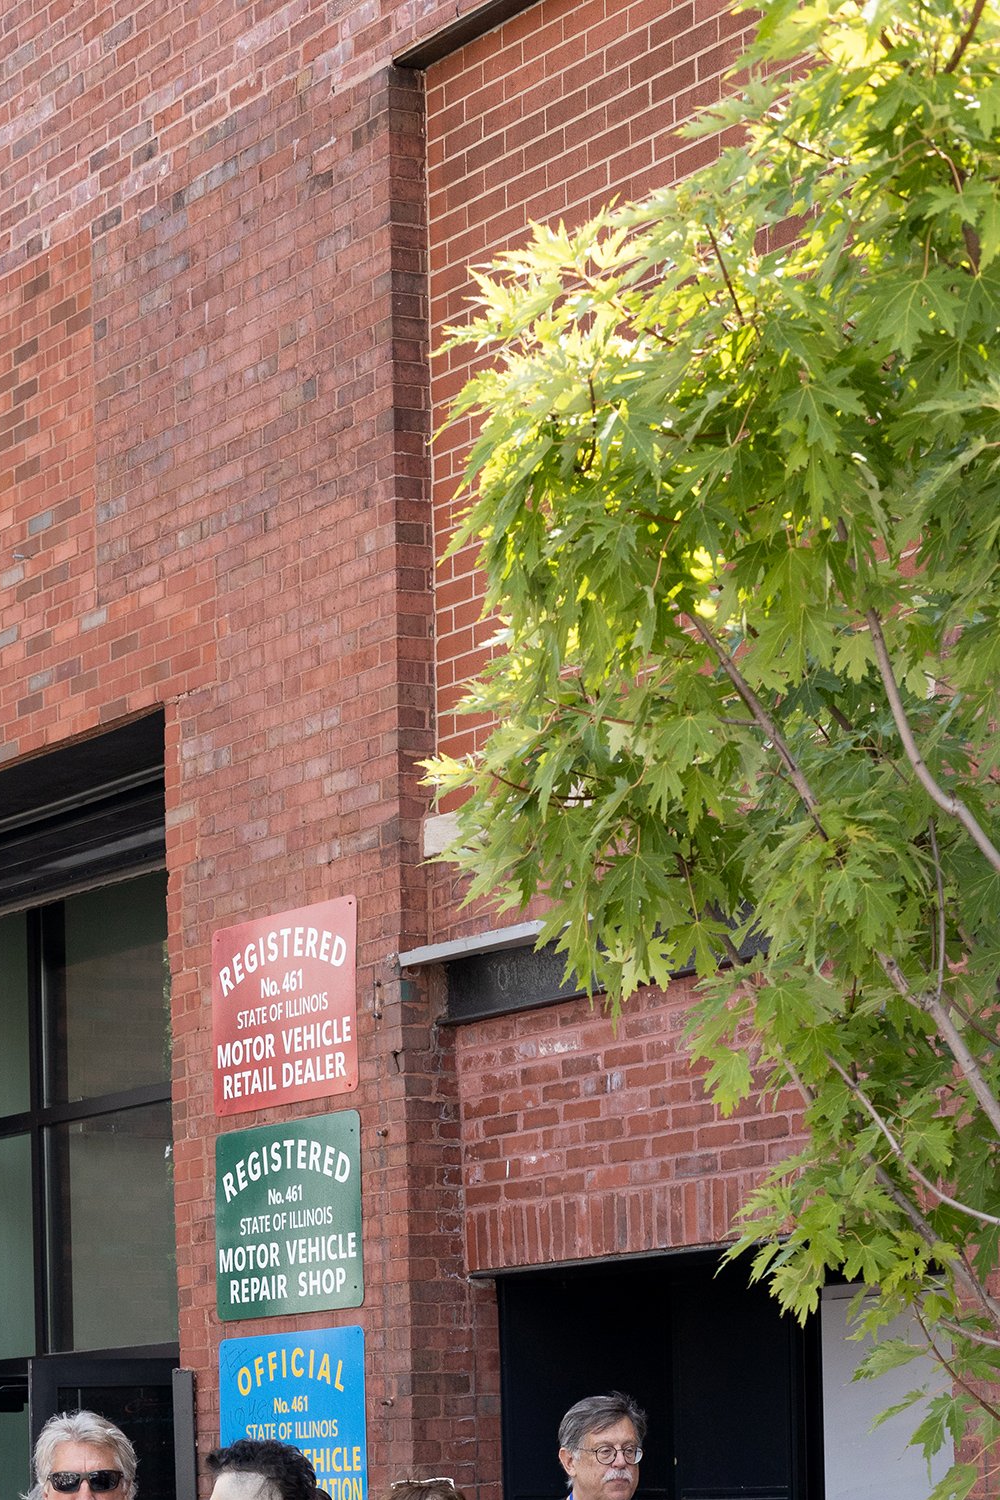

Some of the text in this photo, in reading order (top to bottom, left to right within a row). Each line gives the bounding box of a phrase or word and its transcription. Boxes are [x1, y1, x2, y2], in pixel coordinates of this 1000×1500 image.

[218, 926, 347, 998] REGISTERED
[260, 968, 304, 999] No. 461
[237, 992, 329, 1030] STATE OF ILLINOIS
[217, 1016, 352, 1069] MOTOR VEHICLE
[223, 1051, 347, 1100] RETAIL DEALER
[222, 1138, 351, 1203] REGISTERED
[267, 1184, 303, 1206] No. 461
[240, 1206, 333, 1236] STATE OF ILLINOIS
[219, 1232, 357, 1274] MOTOR VEHICLE
[230, 1267, 347, 1304] REPAIR SHOP
[237, 1347, 345, 1396] OFFICIAL
[273, 1398, 290, 1414] No.
[291, 1395, 309, 1412] 461
[245, 1419, 339, 1441] STATE OF ILLINOIS
[300, 1446, 361, 1473] EHICLE
